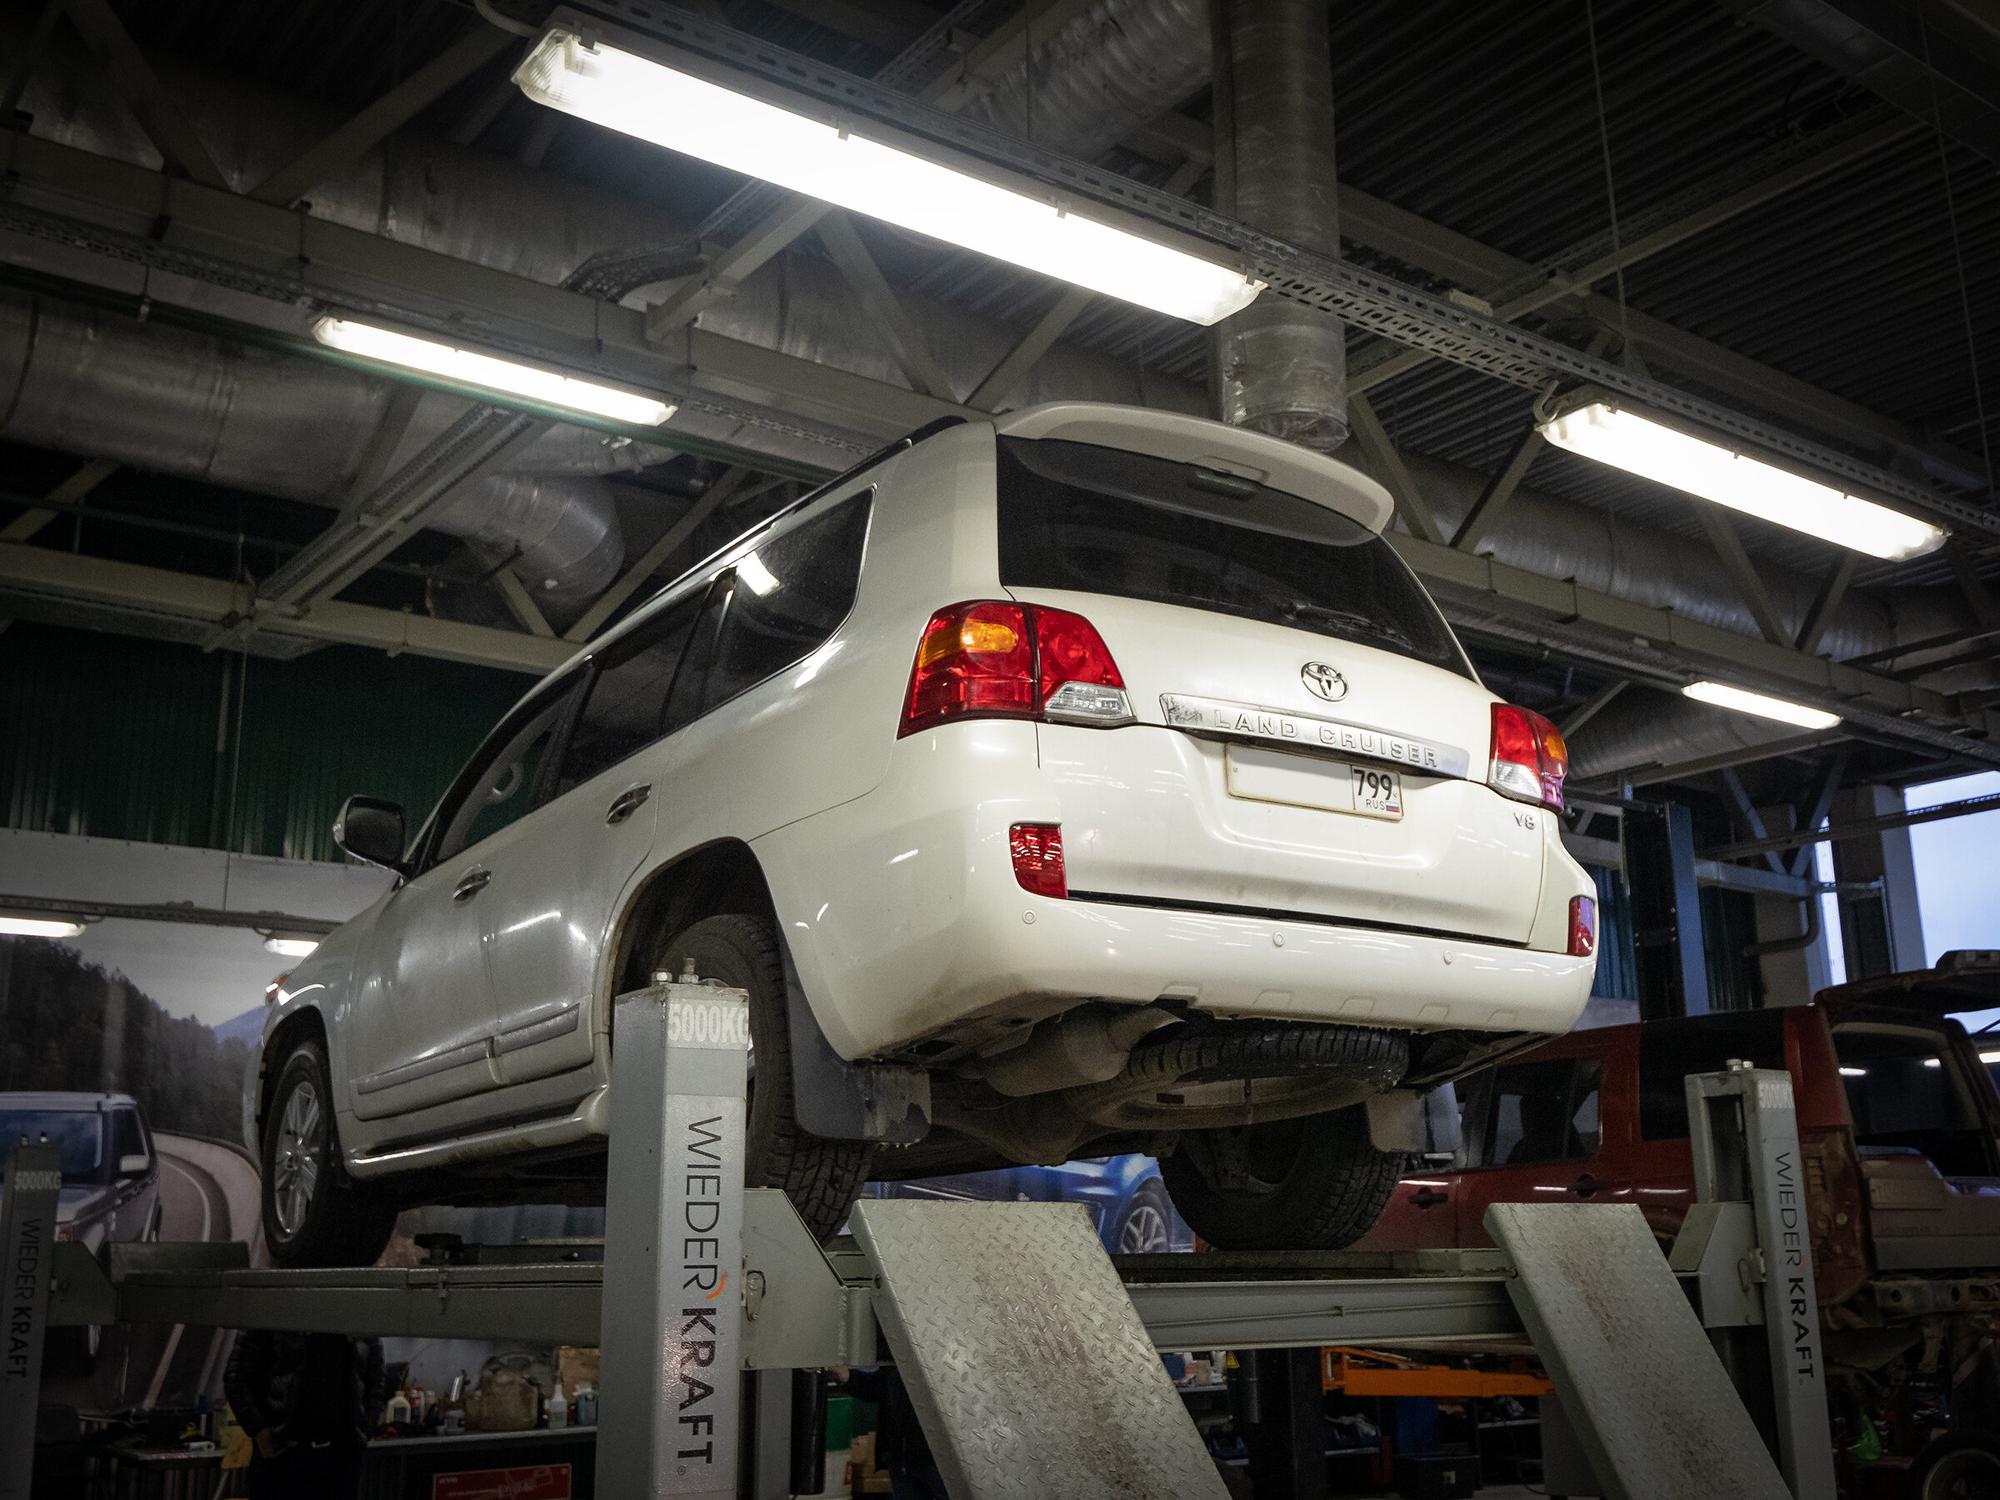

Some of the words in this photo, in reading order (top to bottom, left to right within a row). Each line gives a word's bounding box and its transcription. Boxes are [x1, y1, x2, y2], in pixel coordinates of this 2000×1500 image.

[1214, 709, 1298, 739] LAND
[1319, 726, 1439, 768] CRUISER
[1353, 768, 1393, 800] 799
[1365, 798, 1386, 811] RUS
[1513, 812, 1536, 831] V8
[667, 1003, 749, 1045] 5000KG
[14, 1170, 62, 1191] 5000KG
[682, 1116, 723, 1292] WIEDER
[1775, 1151, 1803, 1268] WIEDER
[14, 1218, 41, 1299] WIEDER
[7, 1306, 33, 1379] KRAFT
[1788, 1276, 1815, 1378] KRAFT
[677, 1307, 717, 1464] KRAFT
